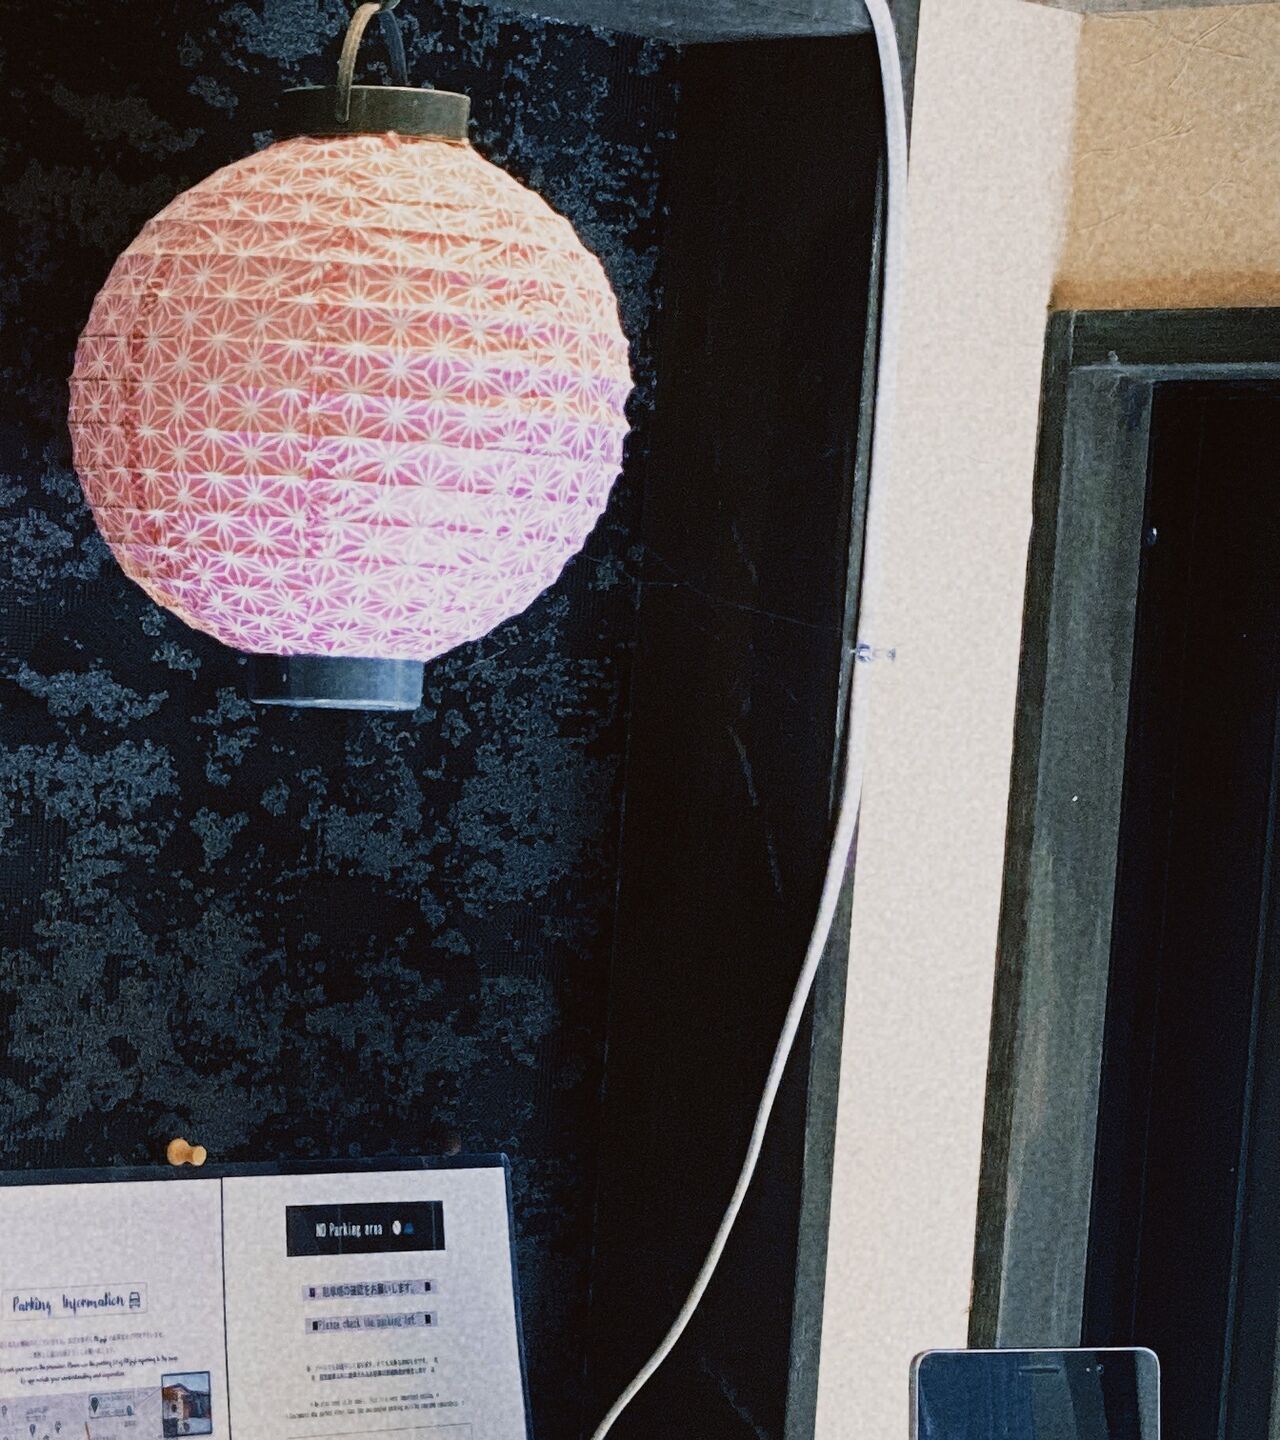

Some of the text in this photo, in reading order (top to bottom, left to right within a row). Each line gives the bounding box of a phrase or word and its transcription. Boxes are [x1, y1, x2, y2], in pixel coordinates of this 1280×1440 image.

[329, 1221, 362, 1238] Parking
[364, 1223, 383, 1236] area
[12, 1290, 127, 1320] Parking Information
